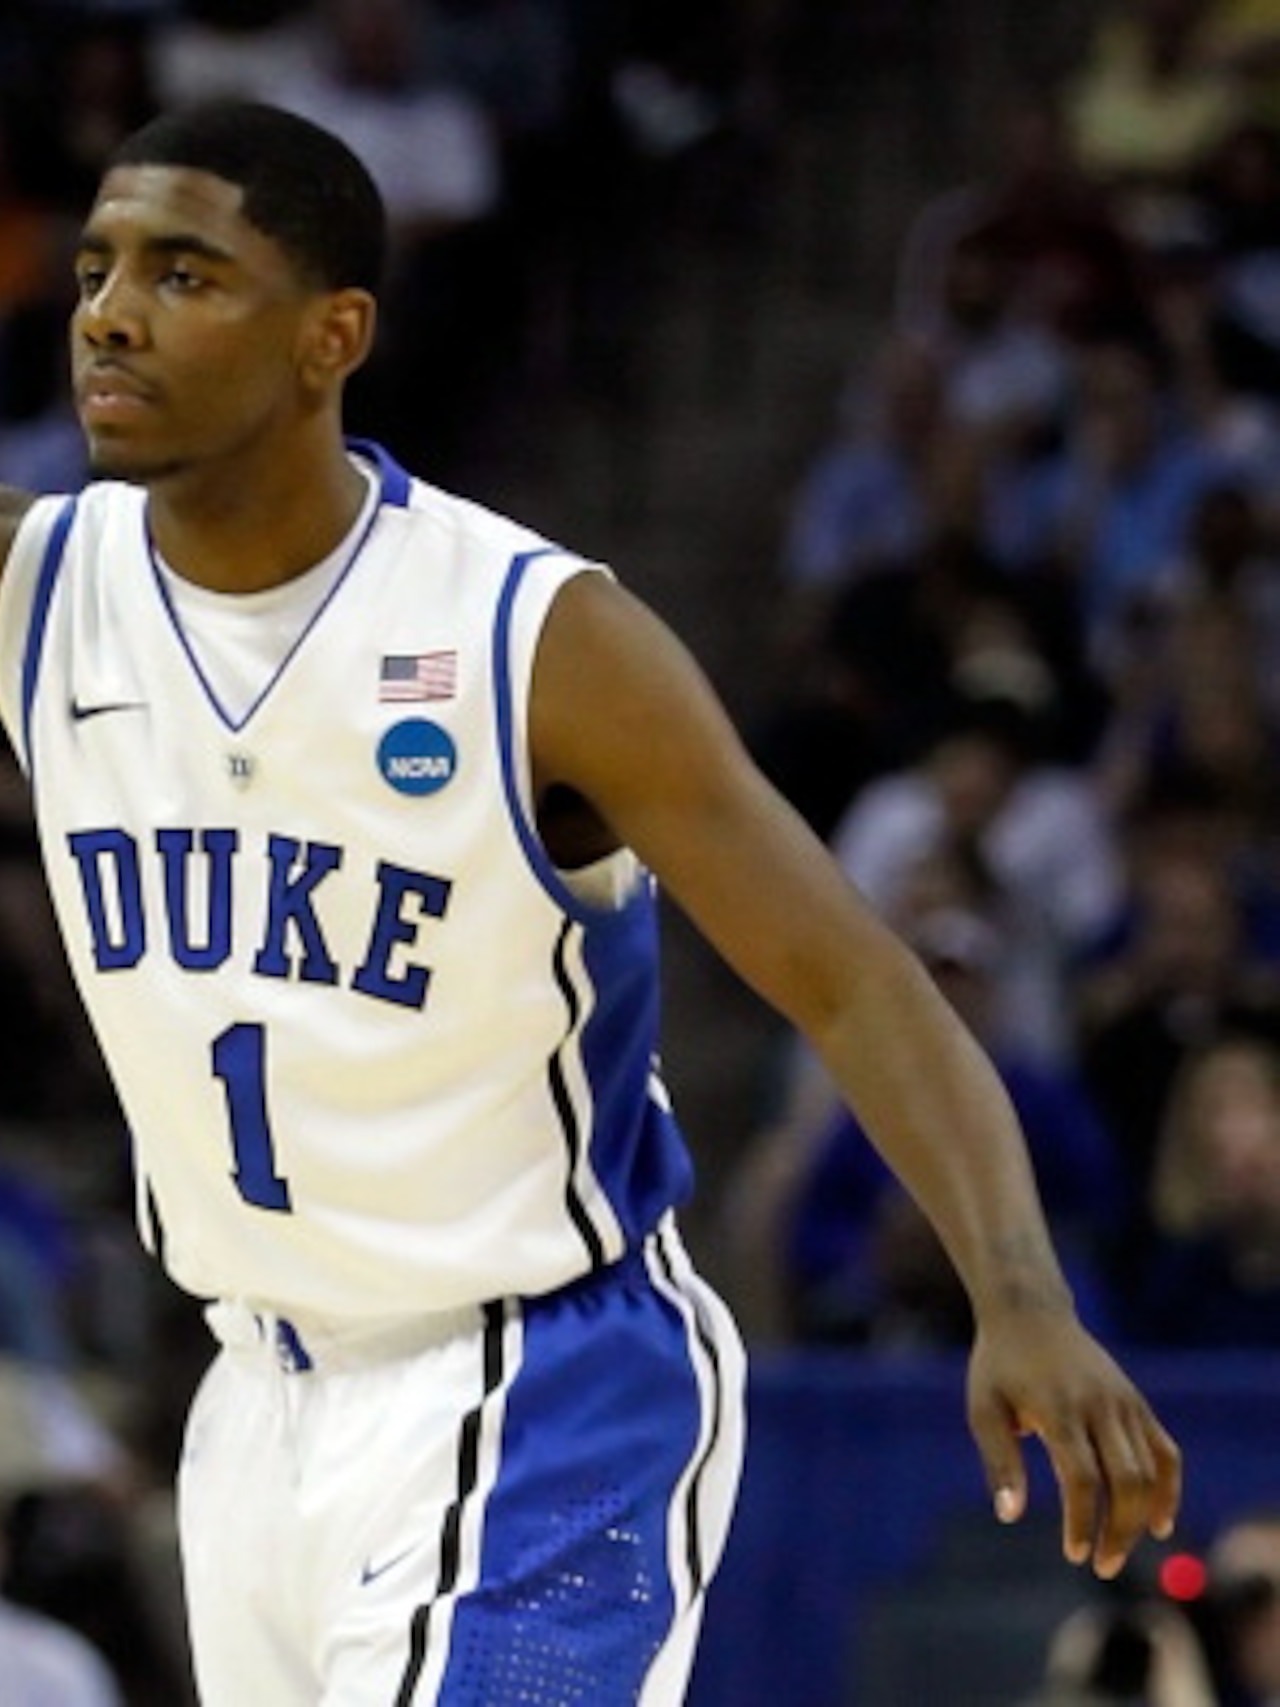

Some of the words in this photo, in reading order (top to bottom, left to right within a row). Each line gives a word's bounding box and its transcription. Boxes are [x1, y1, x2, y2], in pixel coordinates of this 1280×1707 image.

[386, 756, 451, 779] NCAA
[66, 828, 453, 1012] DUKE
[210, 1021, 293, 1214] 1
